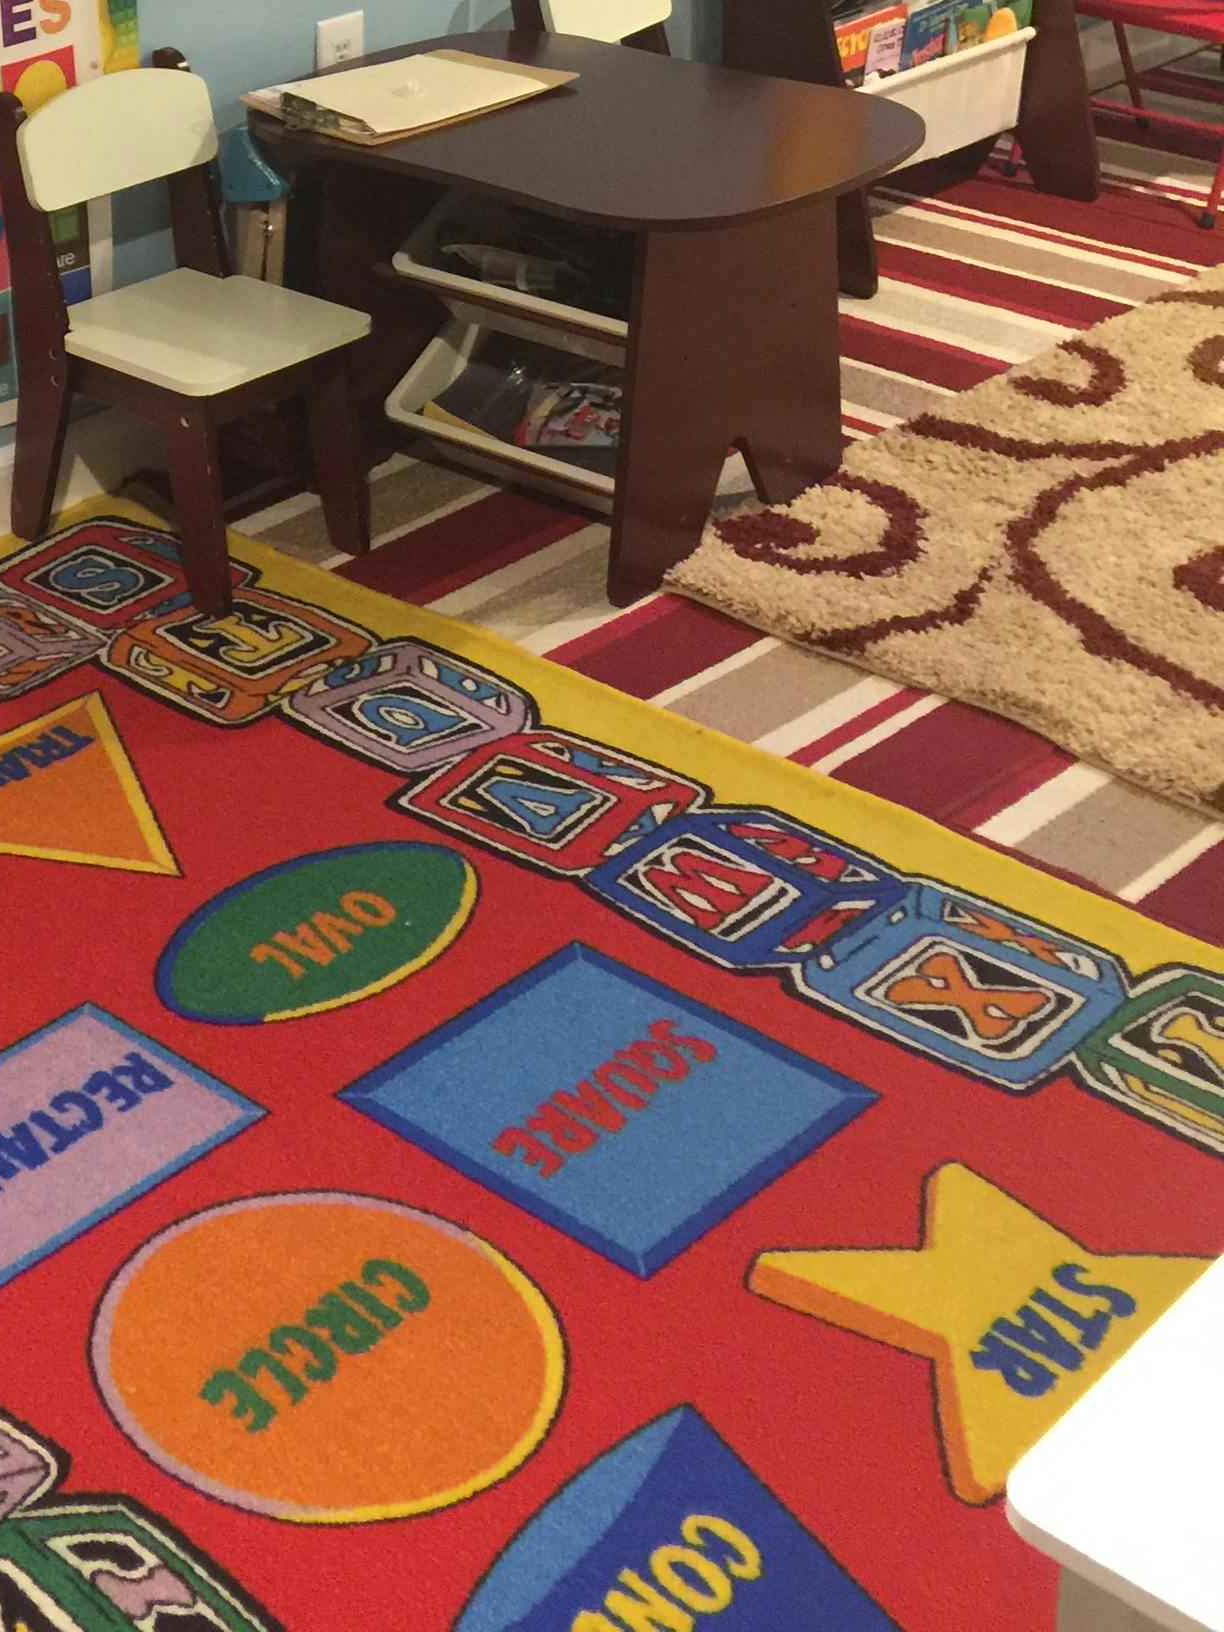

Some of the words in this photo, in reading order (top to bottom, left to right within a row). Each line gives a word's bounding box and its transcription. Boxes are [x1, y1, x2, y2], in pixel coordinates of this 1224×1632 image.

[249, 890, 396, 980] OVAL
[491, 1020, 719, 1180] SQUARE
[197, 1257, 432, 1433] CIRCLE
[968, 1260, 1139, 1399] STAR
